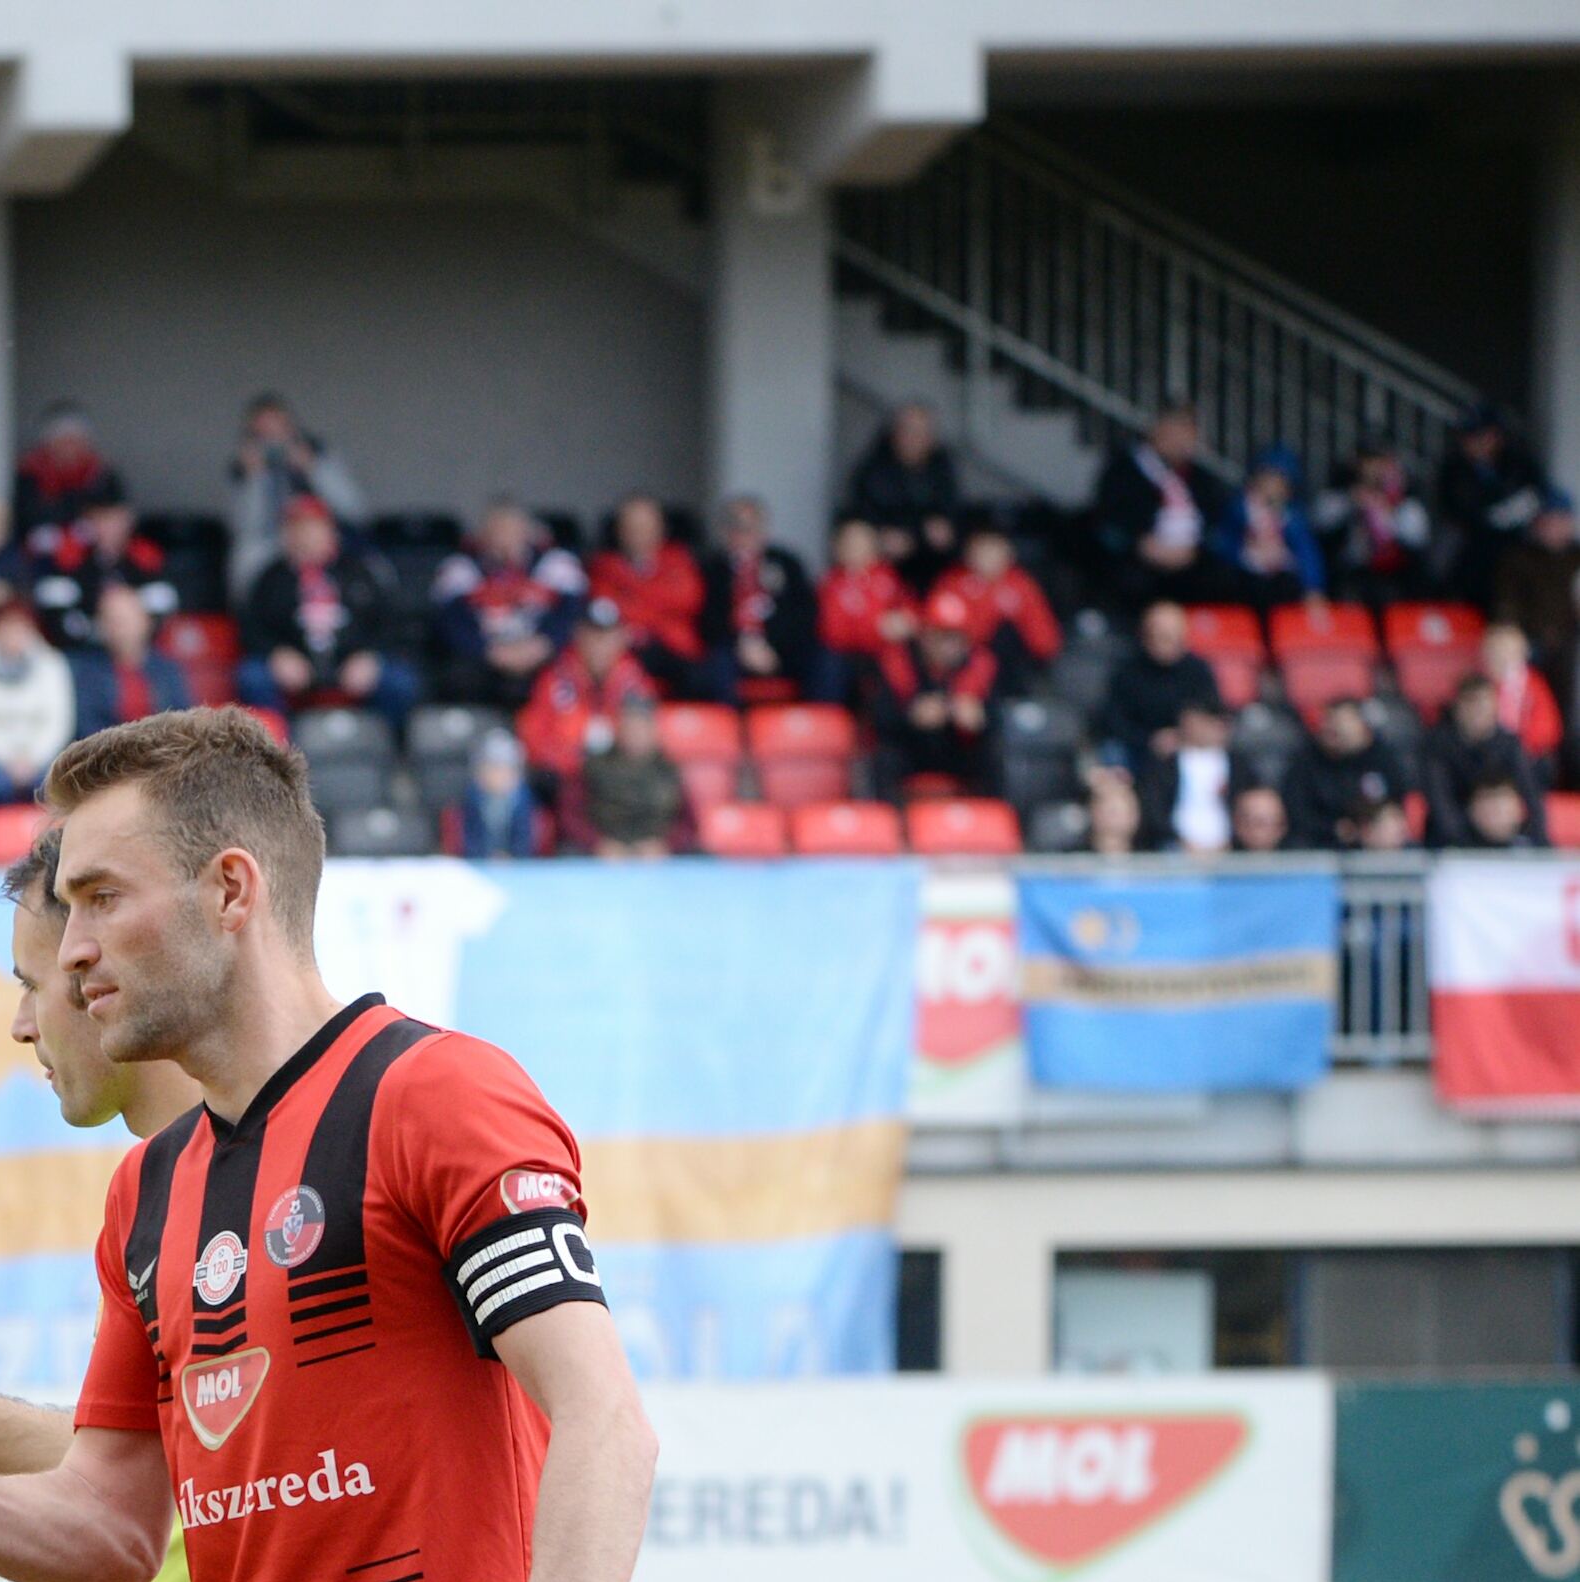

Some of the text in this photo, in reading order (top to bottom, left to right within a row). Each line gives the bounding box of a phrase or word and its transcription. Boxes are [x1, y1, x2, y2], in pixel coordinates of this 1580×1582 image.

[517, 1174, 563, 1202] MOL
[213, 1259, 229, 1276] 120
[551, 1222, 602, 1288] C
[195, 1366, 242, 1408] MOL
[986, 1424, 1157, 1506] MOL
